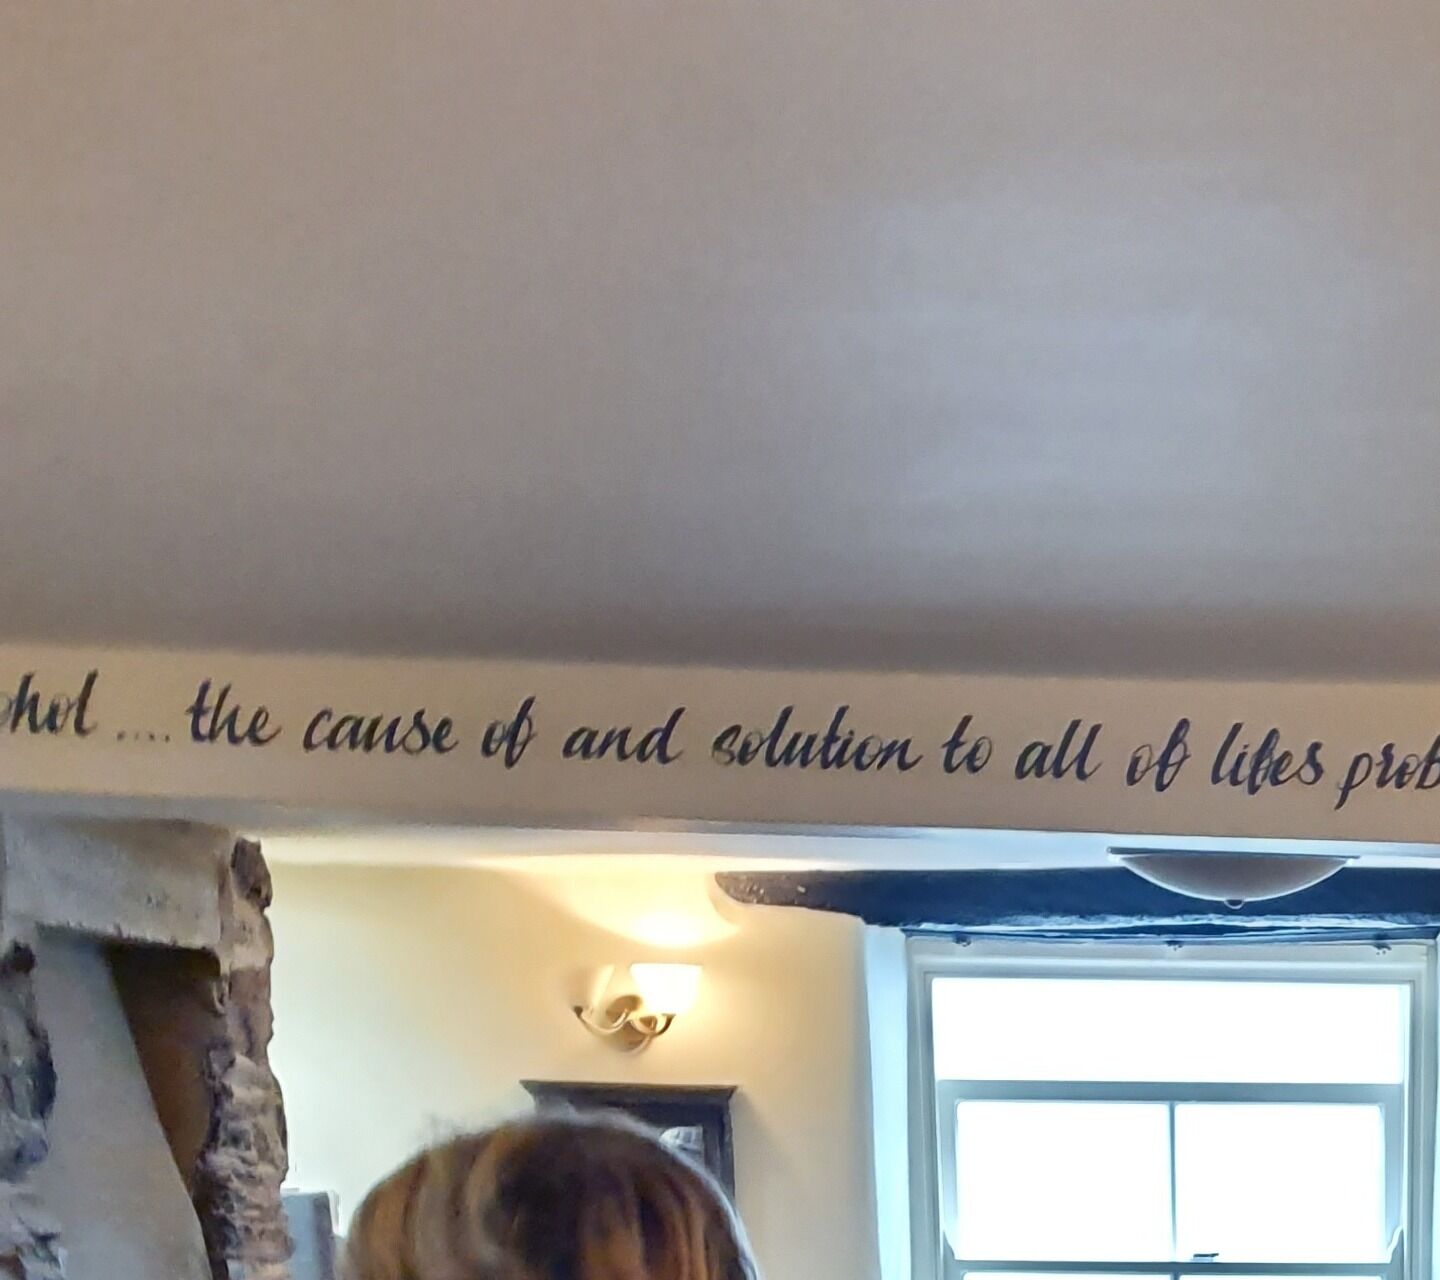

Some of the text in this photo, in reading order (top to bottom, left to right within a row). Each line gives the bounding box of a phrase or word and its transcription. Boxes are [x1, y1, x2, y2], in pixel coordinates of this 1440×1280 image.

[184, 678, 283, 747] the
[302, 707, 460, 758] cause
[481, 695, 538, 770] of
[562, 705, 686, 766] and
[711, 705, 926, 774] solution
[940, 715, 993, 774] to
[1014, 719, 1104, 782] all
[1126, 718, 1191, 792] of
[1211, 722, 1326, 796] lifes
